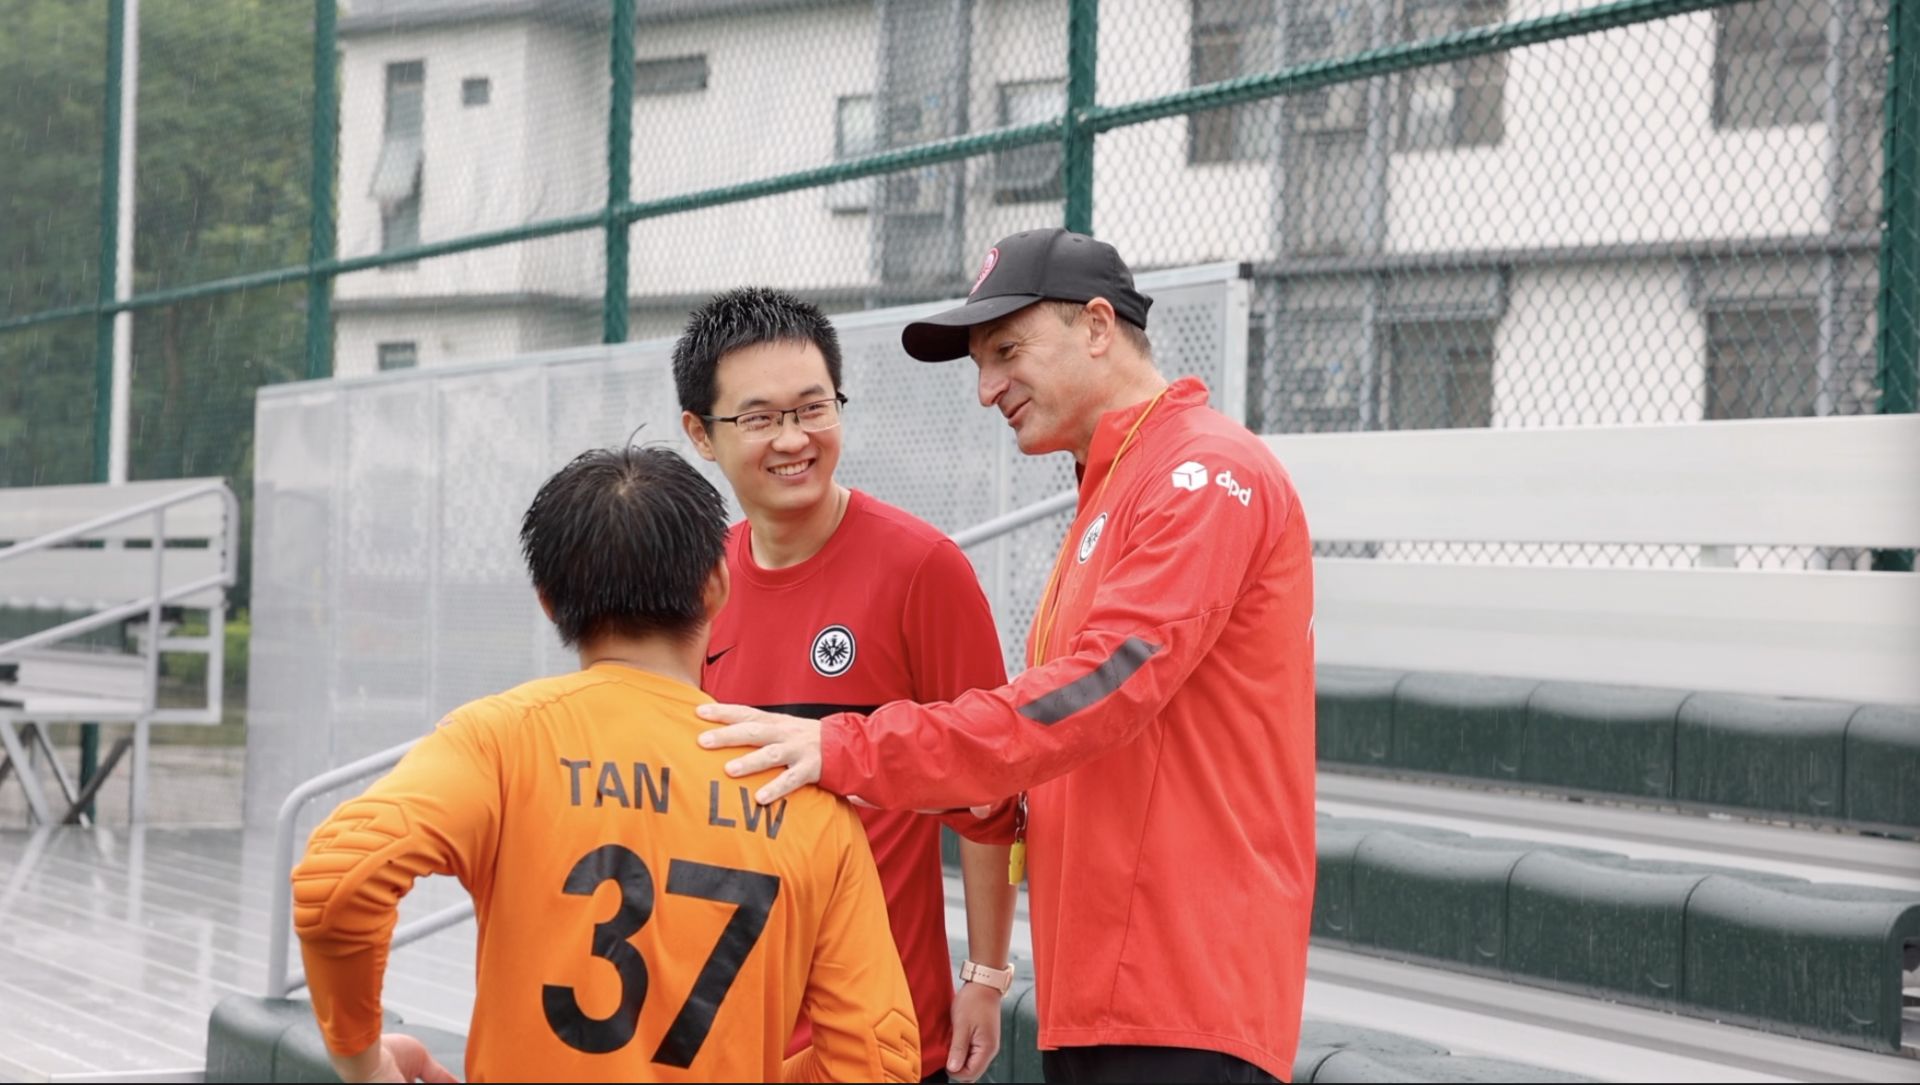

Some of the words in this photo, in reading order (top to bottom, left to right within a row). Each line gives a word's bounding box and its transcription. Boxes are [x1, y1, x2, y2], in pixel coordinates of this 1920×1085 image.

[1215, 470, 1252, 506] dpd
[560, 757, 670, 814] TAN
[708, 780, 787, 840] LW
[542, 843, 781, 1070] 37
